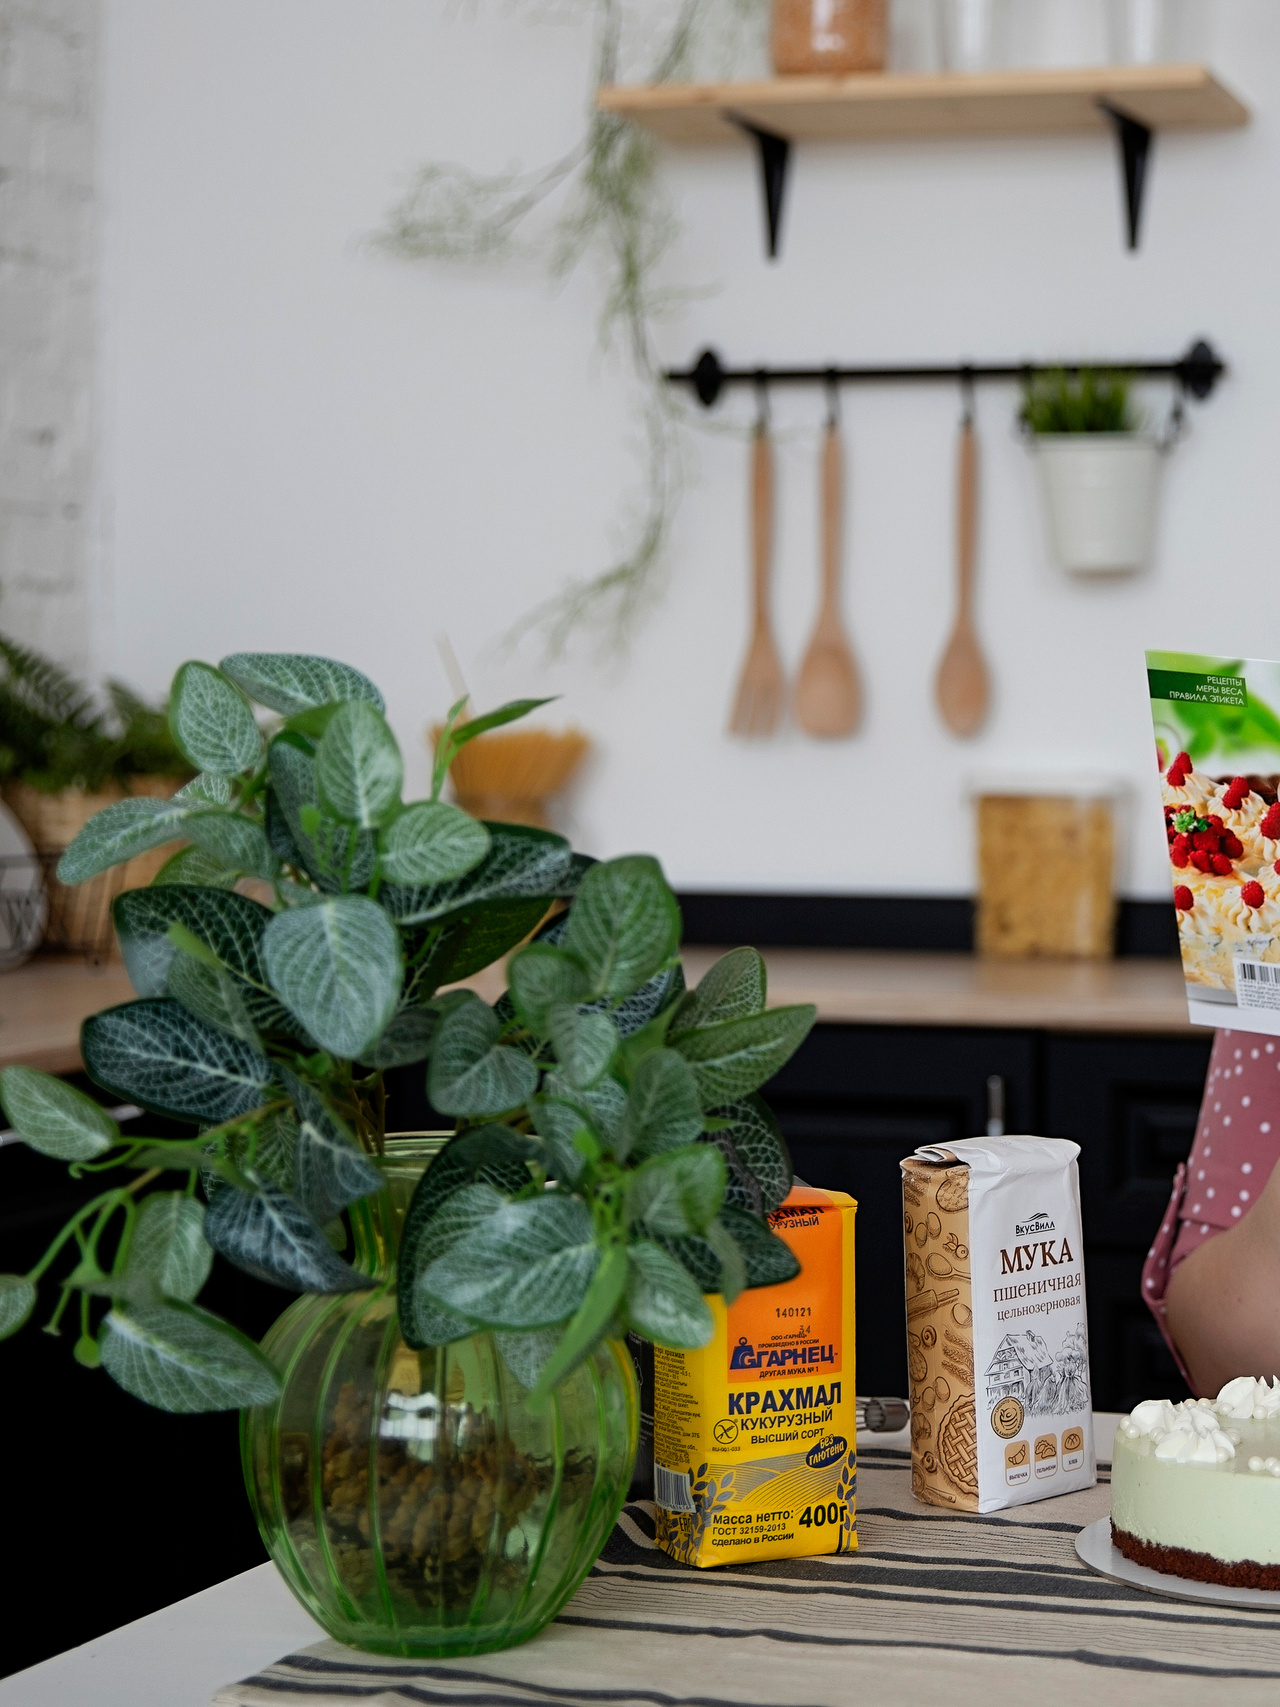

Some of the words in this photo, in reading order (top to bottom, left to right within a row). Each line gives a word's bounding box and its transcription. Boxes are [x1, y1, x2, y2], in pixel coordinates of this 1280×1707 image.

[1207, 676, 1242, 686] РЕЦЕПТЫ
[1169, 691, 1208, 701] ПРАВИЛА
[1209, 695, 1244, 705] ЭТИКЕТА
[1196, 685, 1219, 693] МЕРЫ
[1221, 688, 1243, 696] ВЕСА
[769, 1215, 819, 1230] УРУЗНЫЙ
[1015, 1221, 1055, 1235] ВкусВилл
[1000, 1237, 1074, 1275] МУКА
[993, 1272, 1082, 1303] пшеничная
[775, 1307, 811, 1318] 140121
[997, 1295, 1081, 1322] цельнозерновая
[759, 1369, 786, 1379] ДРУГАЯ
[787, 1367, 806, 1376] МУКА
[728, 1381, 841, 1415] КРАХМАЛ
[741, 1406, 833, 1431] КУКУРУЗНЫЙ
[751, 1430, 799, 1444] ВЫСШИЙ
[800, 1428, 825, 1439] СОРТ
[756, 1509, 794, 1523] нетто:
[799, 1502, 848, 1528] 400г
[713, 1526, 737, 1535] ГОСТ
[739, 1523, 786, 1535] 32159-2013
[712, 1537, 752, 1547] сделано
[762, 1532, 794, 1543] России
